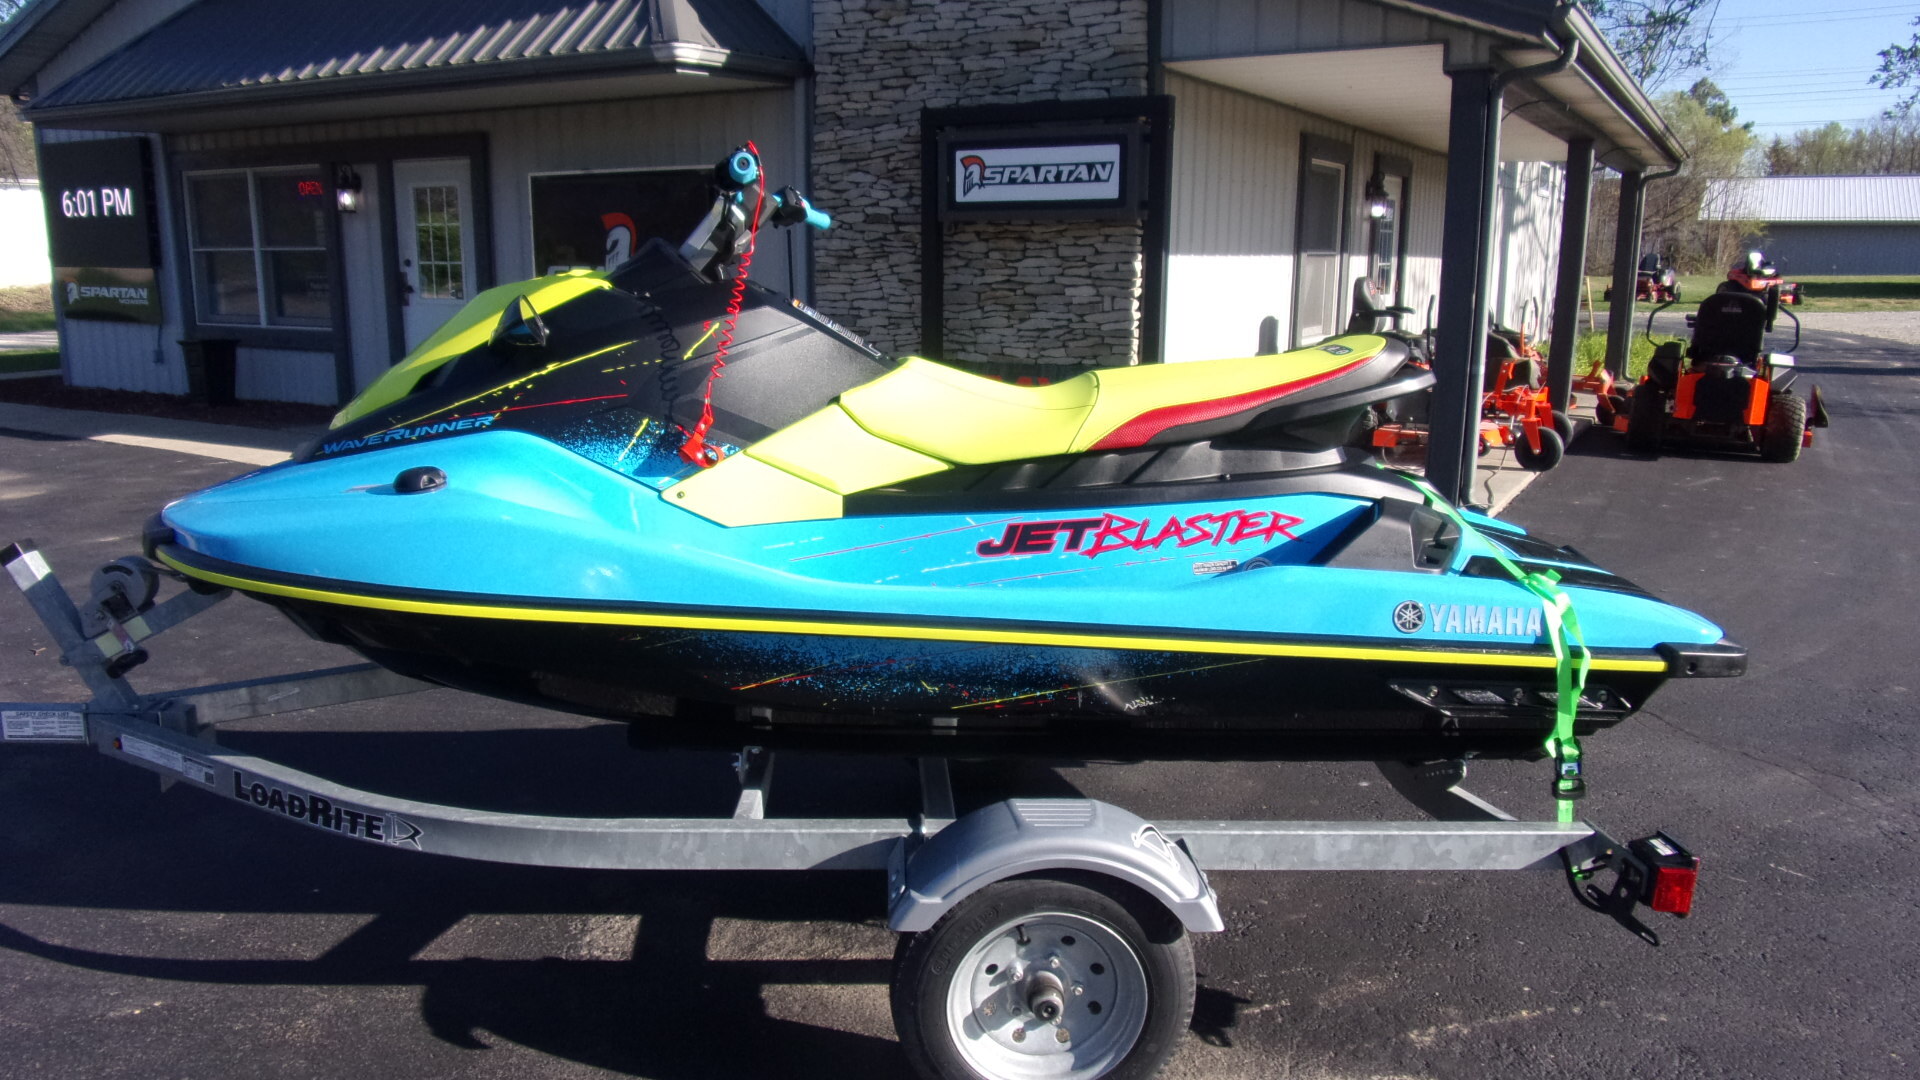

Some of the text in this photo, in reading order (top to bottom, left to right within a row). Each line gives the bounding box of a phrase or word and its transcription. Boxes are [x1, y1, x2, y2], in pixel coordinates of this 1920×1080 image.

[983, 162, 1114, 184] SPARTAN
[298, 181, 323, 195] OPEN
[62, 188, 133, 217] 6:01 PM
[80, 286, 148, 299] SPARTAN
[1429, 603, 1543, 637] YAMAHA
